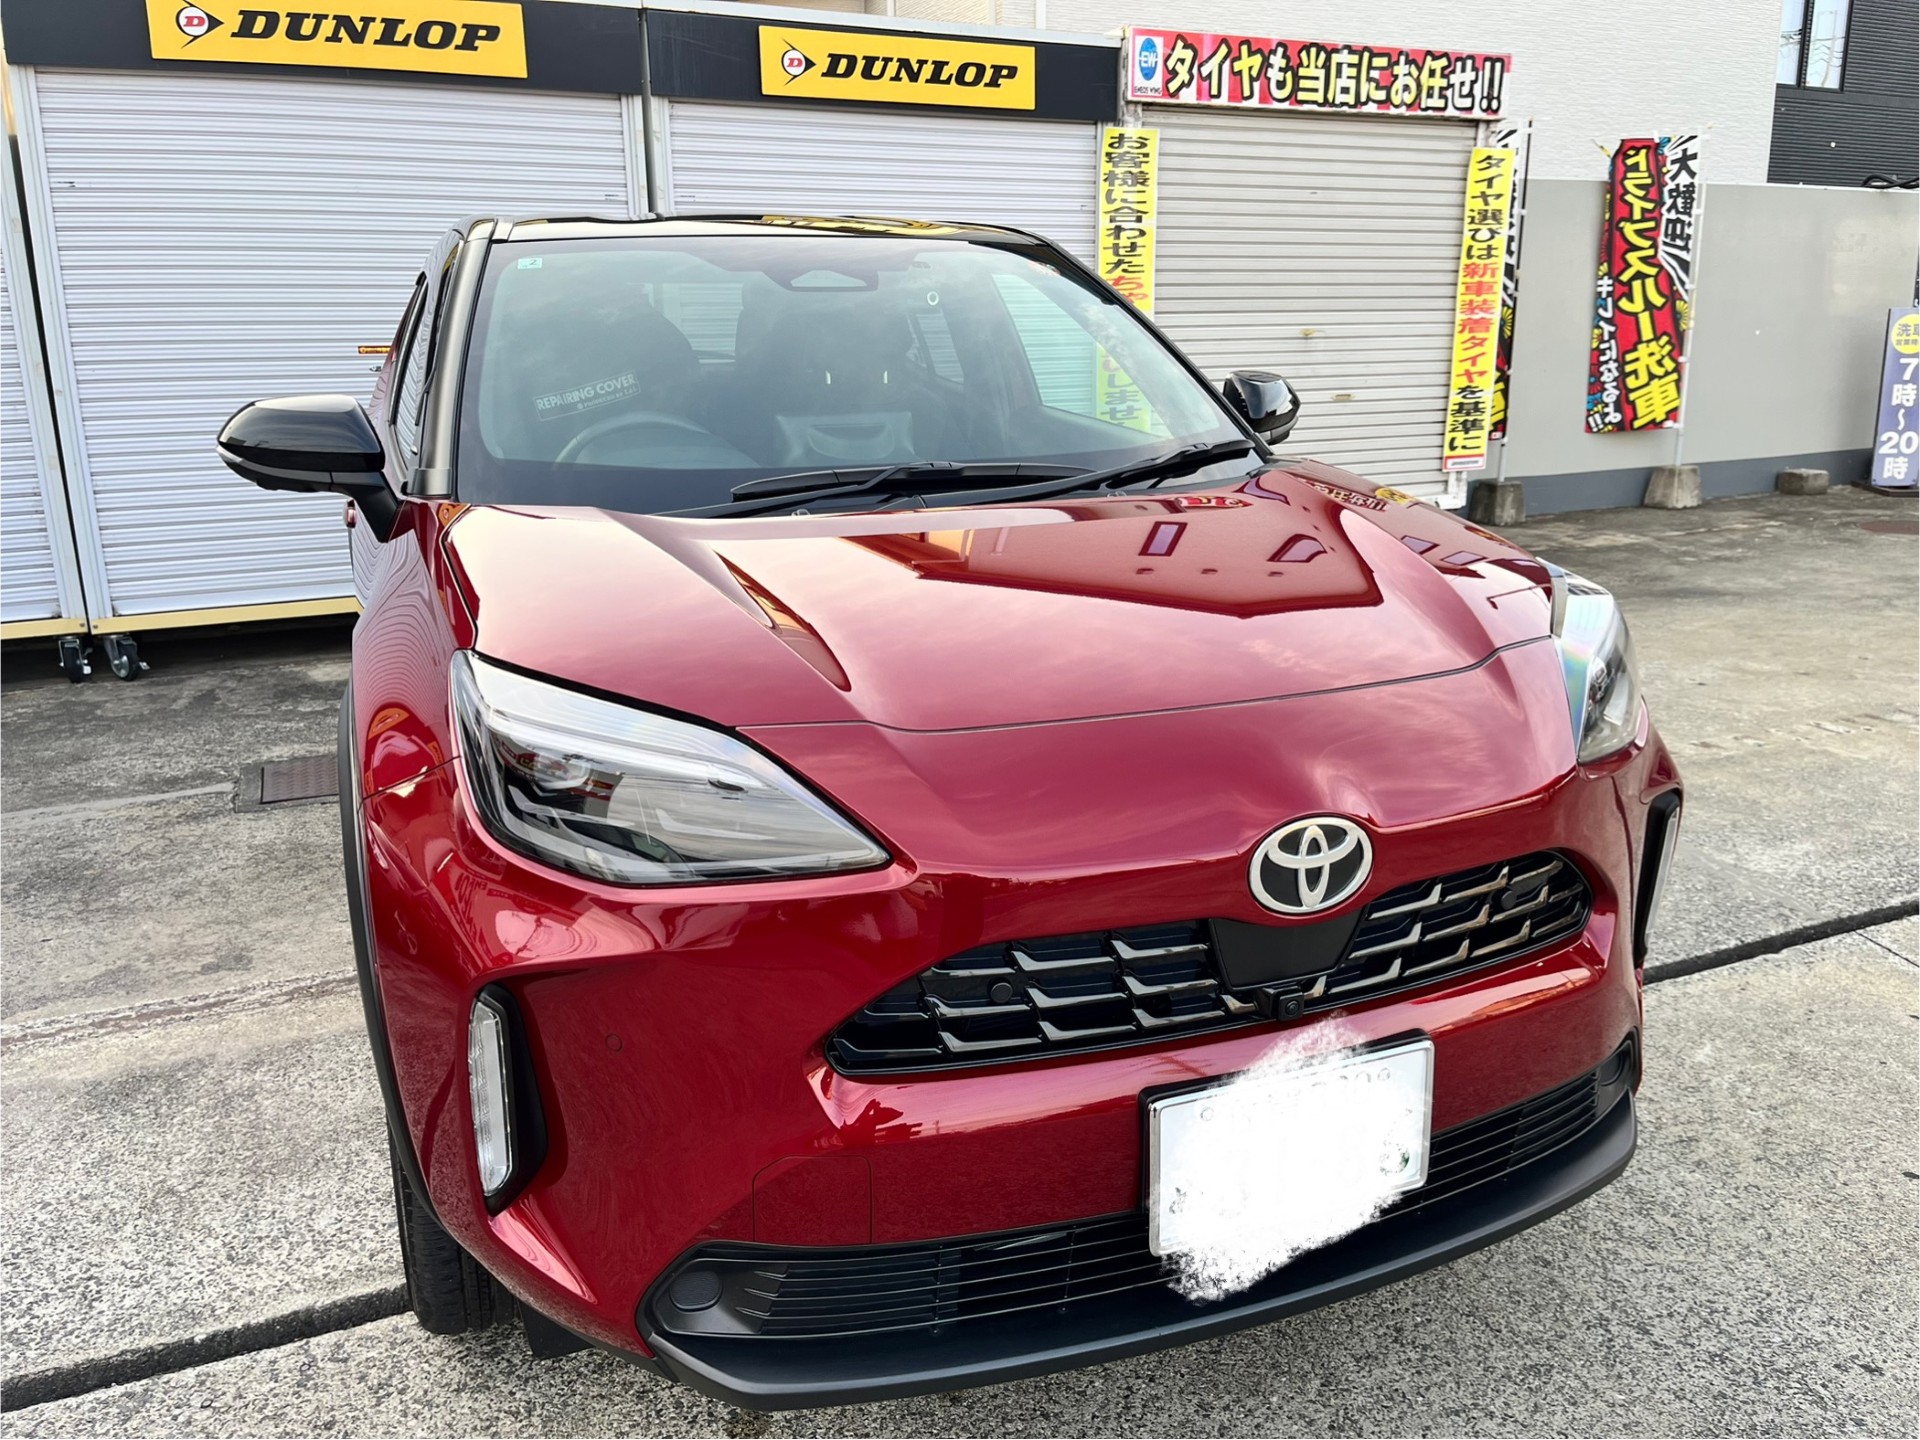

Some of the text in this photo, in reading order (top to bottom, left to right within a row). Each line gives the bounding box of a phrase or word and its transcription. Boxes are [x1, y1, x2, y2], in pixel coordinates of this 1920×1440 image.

[230, 9, 501, 52] DUNLOP
[821, 53, 1018, 88] DUNLOP
[536, 386, 595, 410] REPAIRING
[596, 373, 636, 394] COVER
